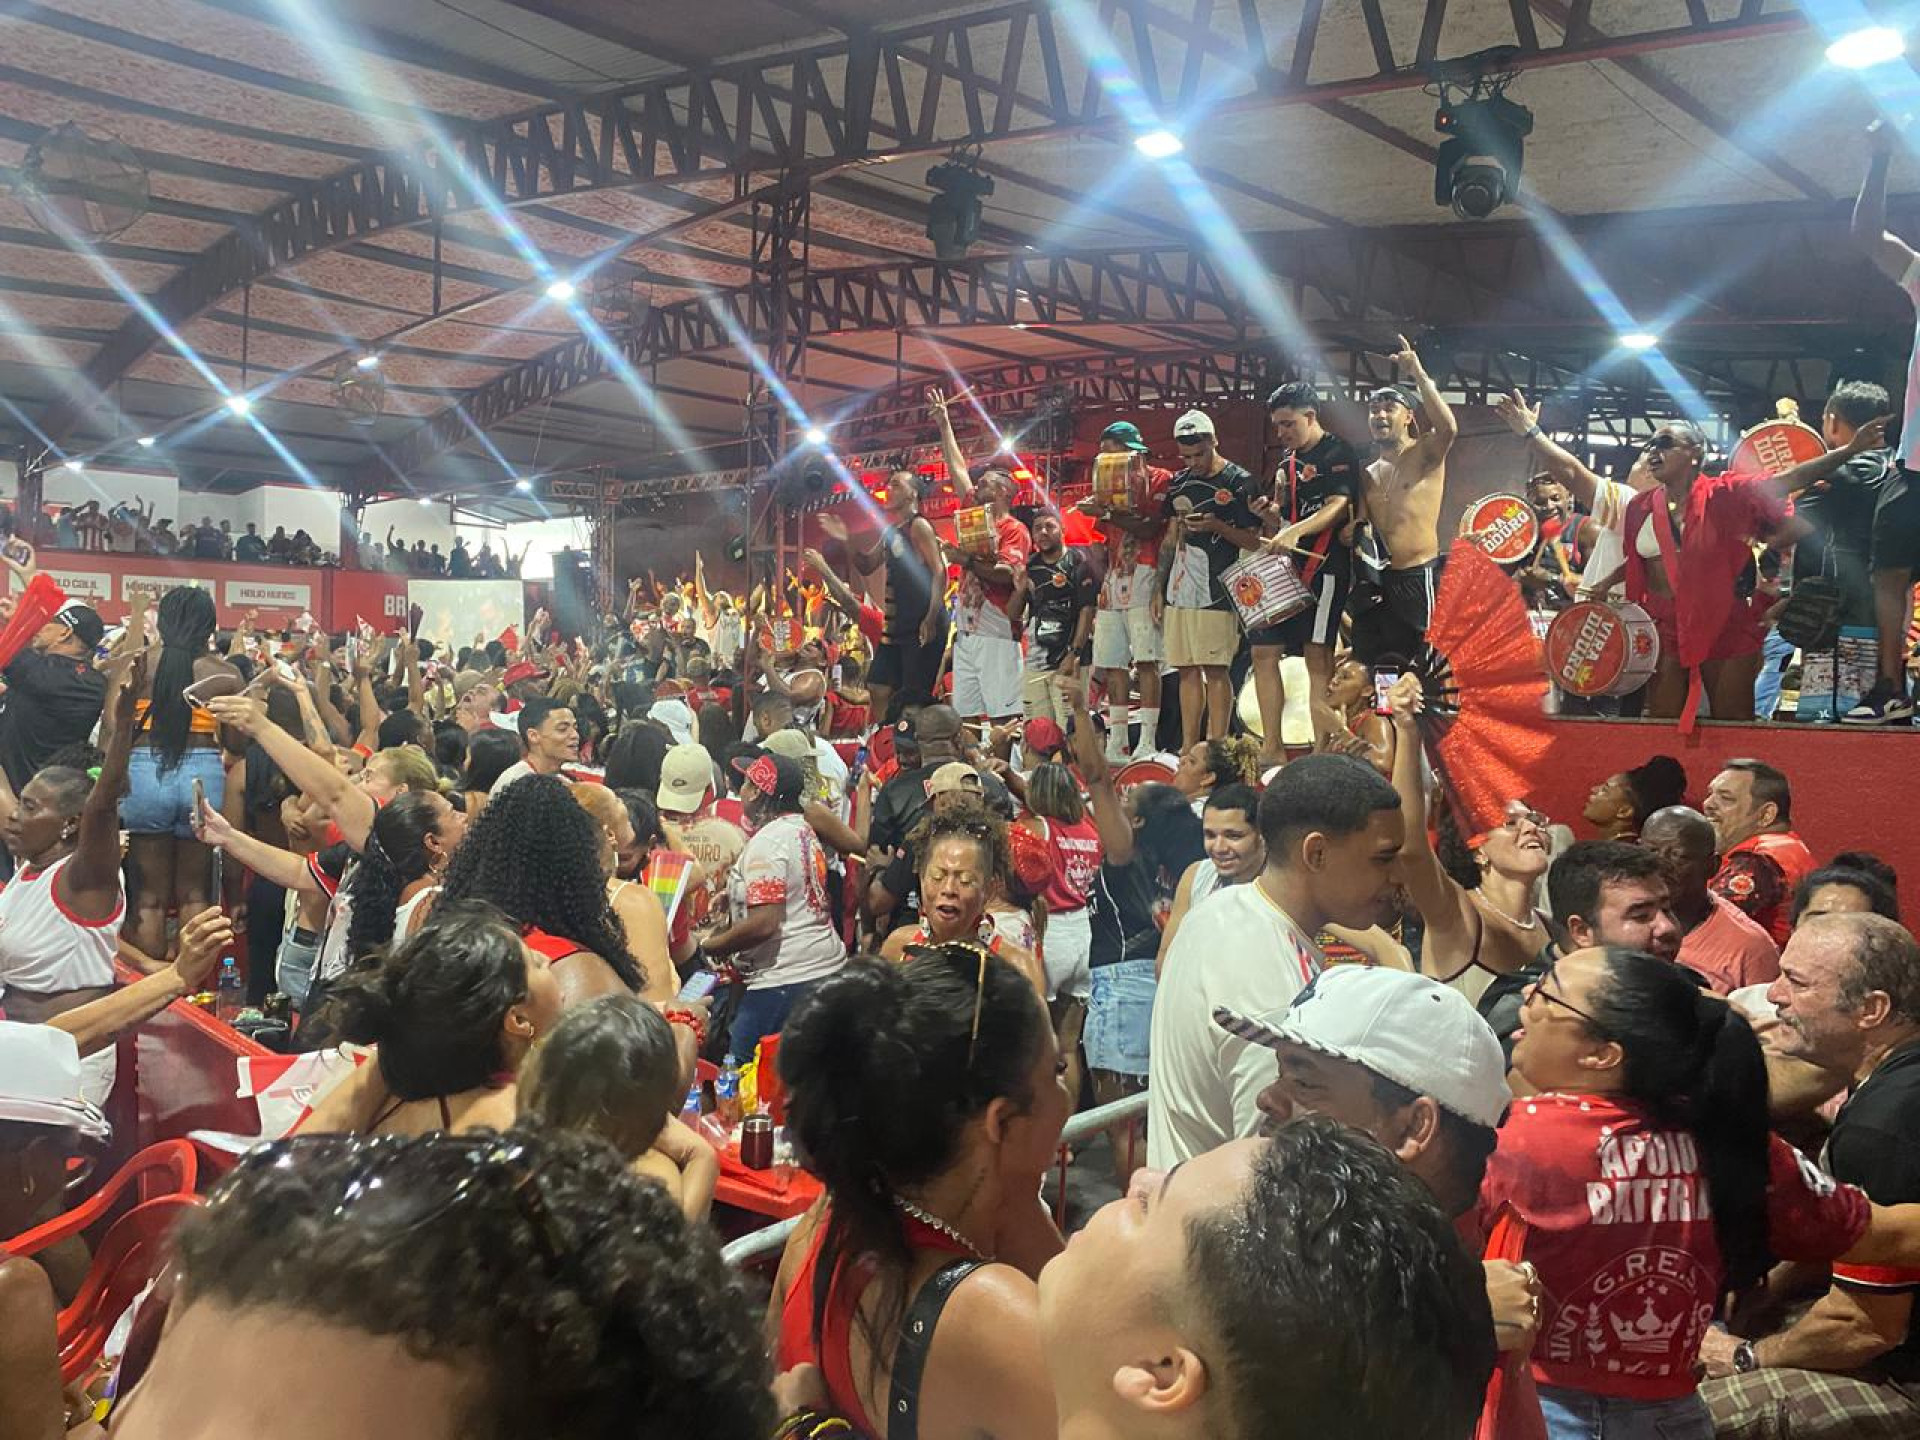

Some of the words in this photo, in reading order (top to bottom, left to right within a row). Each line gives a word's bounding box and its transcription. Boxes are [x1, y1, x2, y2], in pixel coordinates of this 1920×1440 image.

[1484, 511, 1530, 553] DOURO
[1563, 611, 1603, 681] DOURO
[1585, 621, 1614, 661] VIRA
[1598, 1130, 1699, 1179] APOIO
